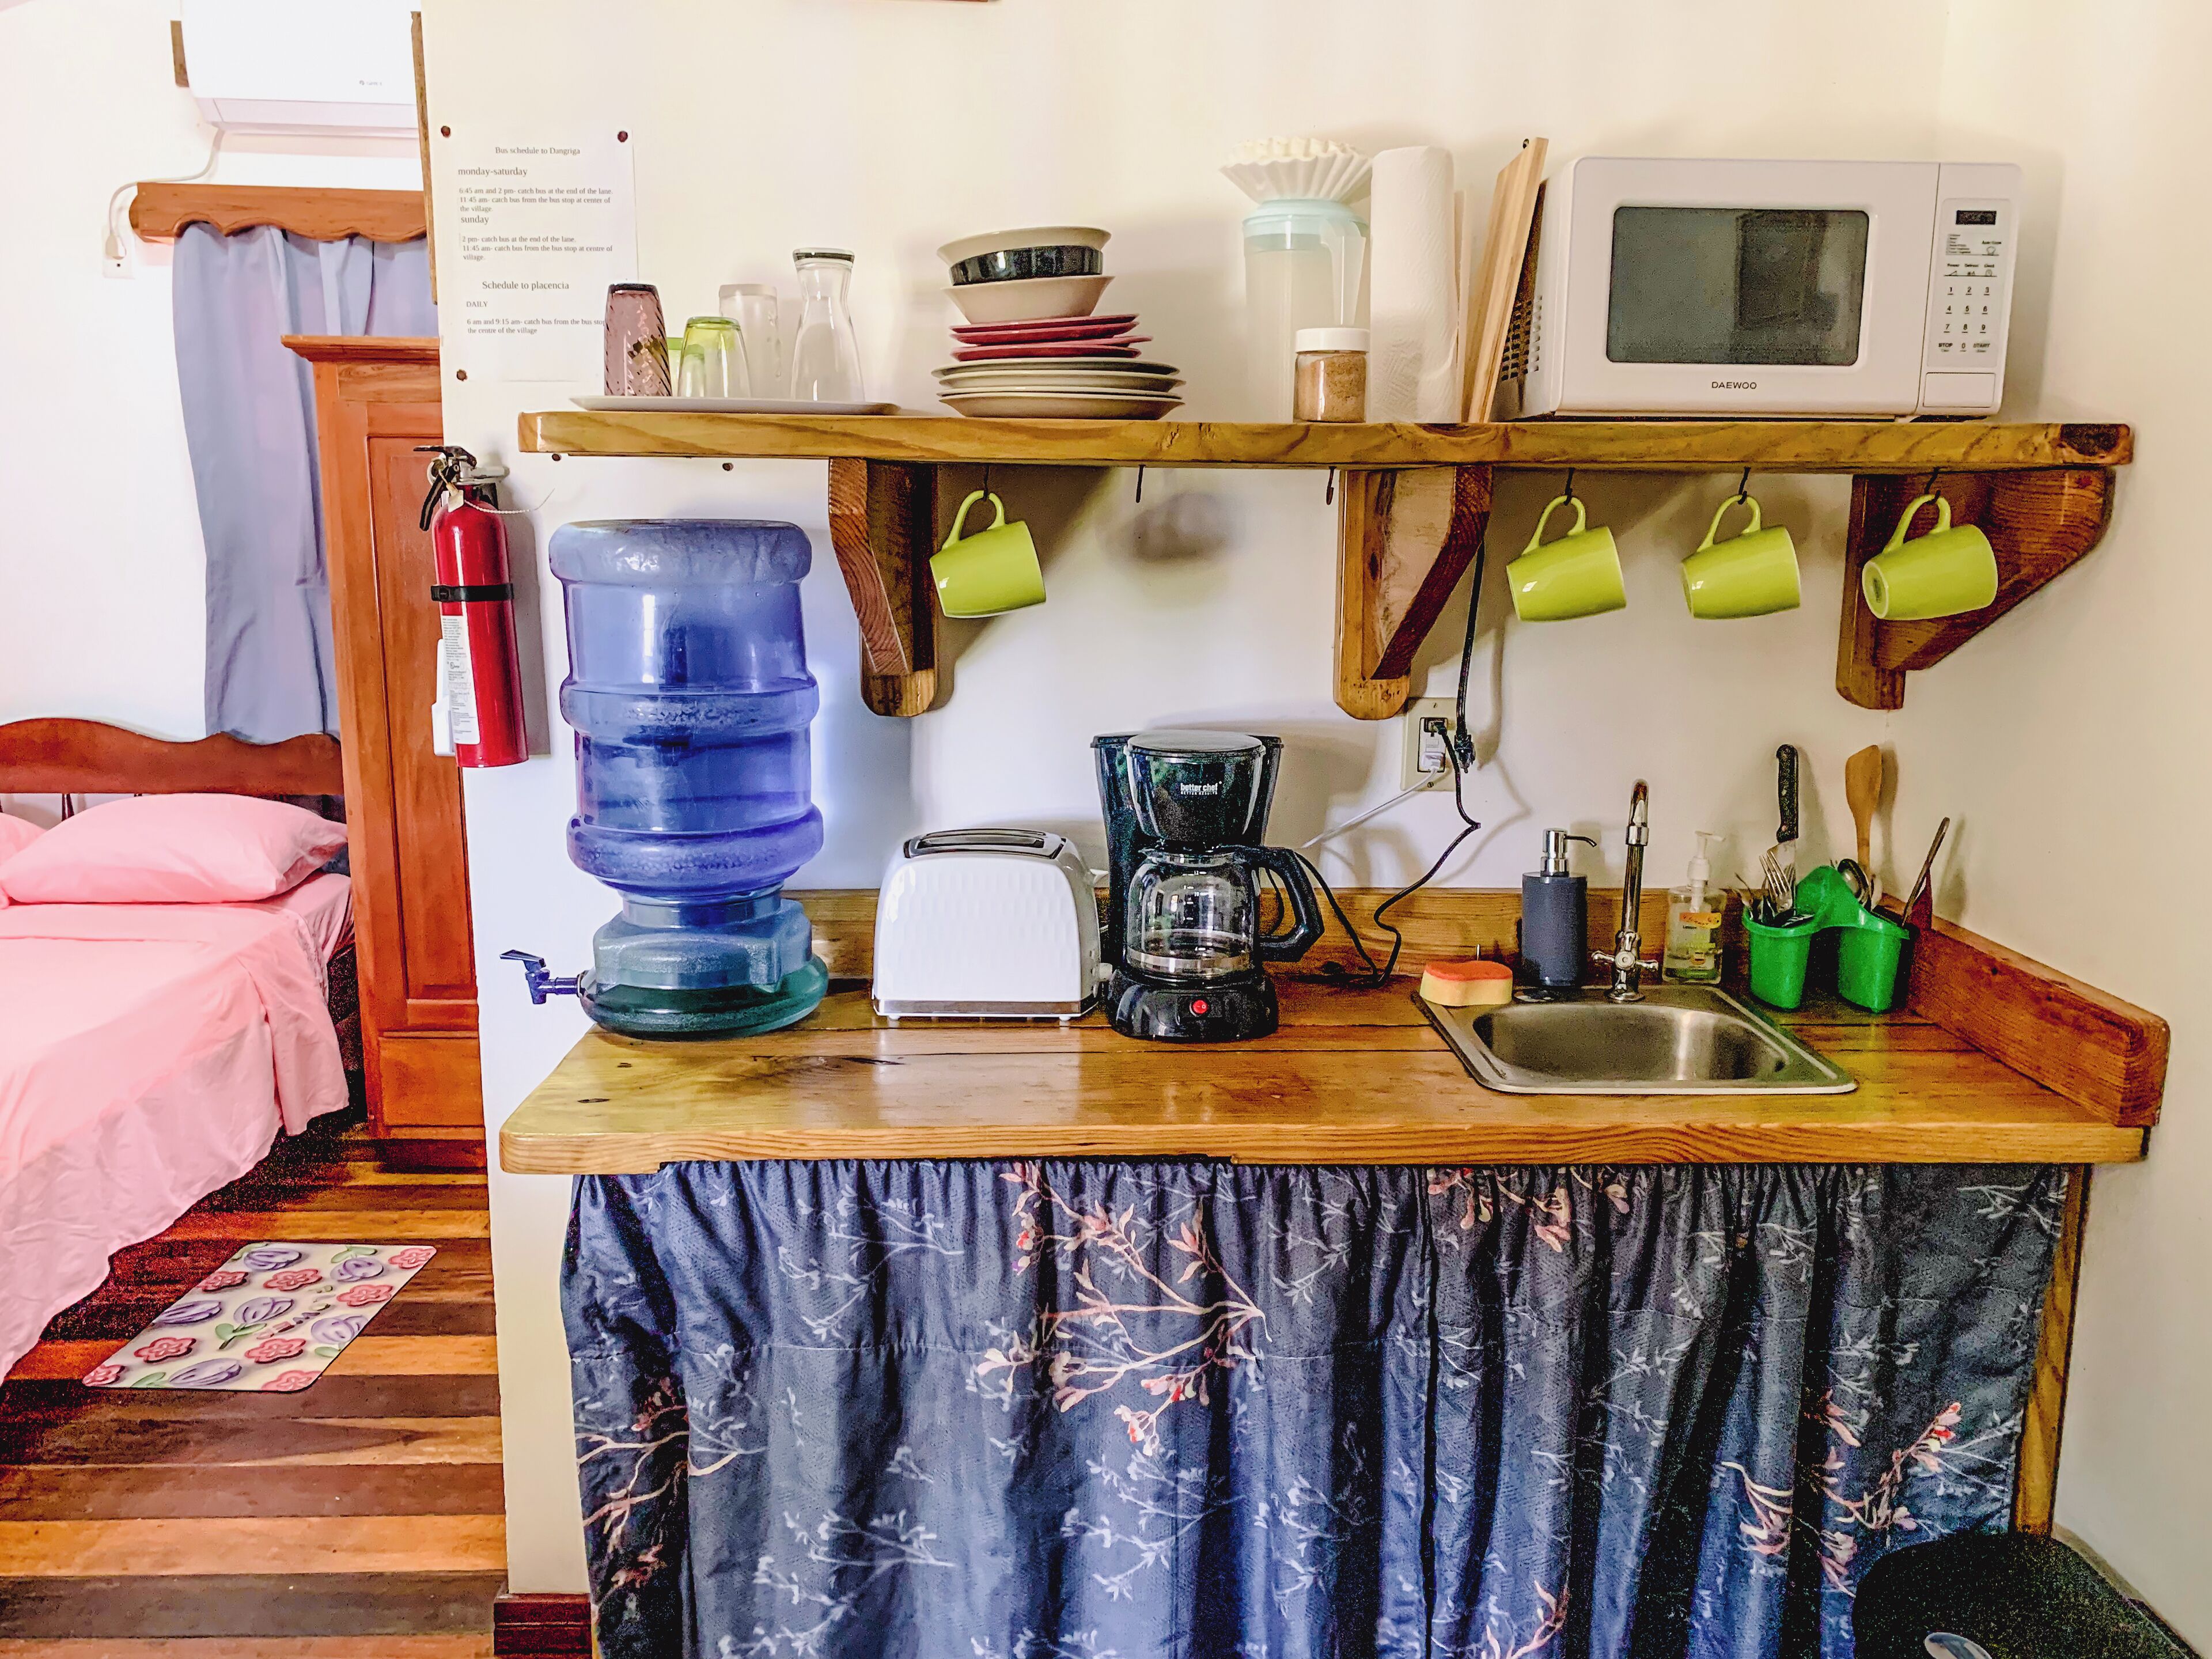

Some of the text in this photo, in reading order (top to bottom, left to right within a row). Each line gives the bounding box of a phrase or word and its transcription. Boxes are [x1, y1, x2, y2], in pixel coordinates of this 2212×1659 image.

[495, 146, 509, 154] Bus
[509, 146, 540, 154] schedule
[549, 147, 581, 156] Dangriga
[457, 166, 528, 178] monday-saturday
[460, 214, 489, 226] sunday
[482, 281, 519, 290] Schedule
[531, 281, 570, 291] placencia
[517, 327, 538, 335] village
[1711, 381, 1757, 389] DAEWOO
[1180, 782, 1218, 791] better chef
